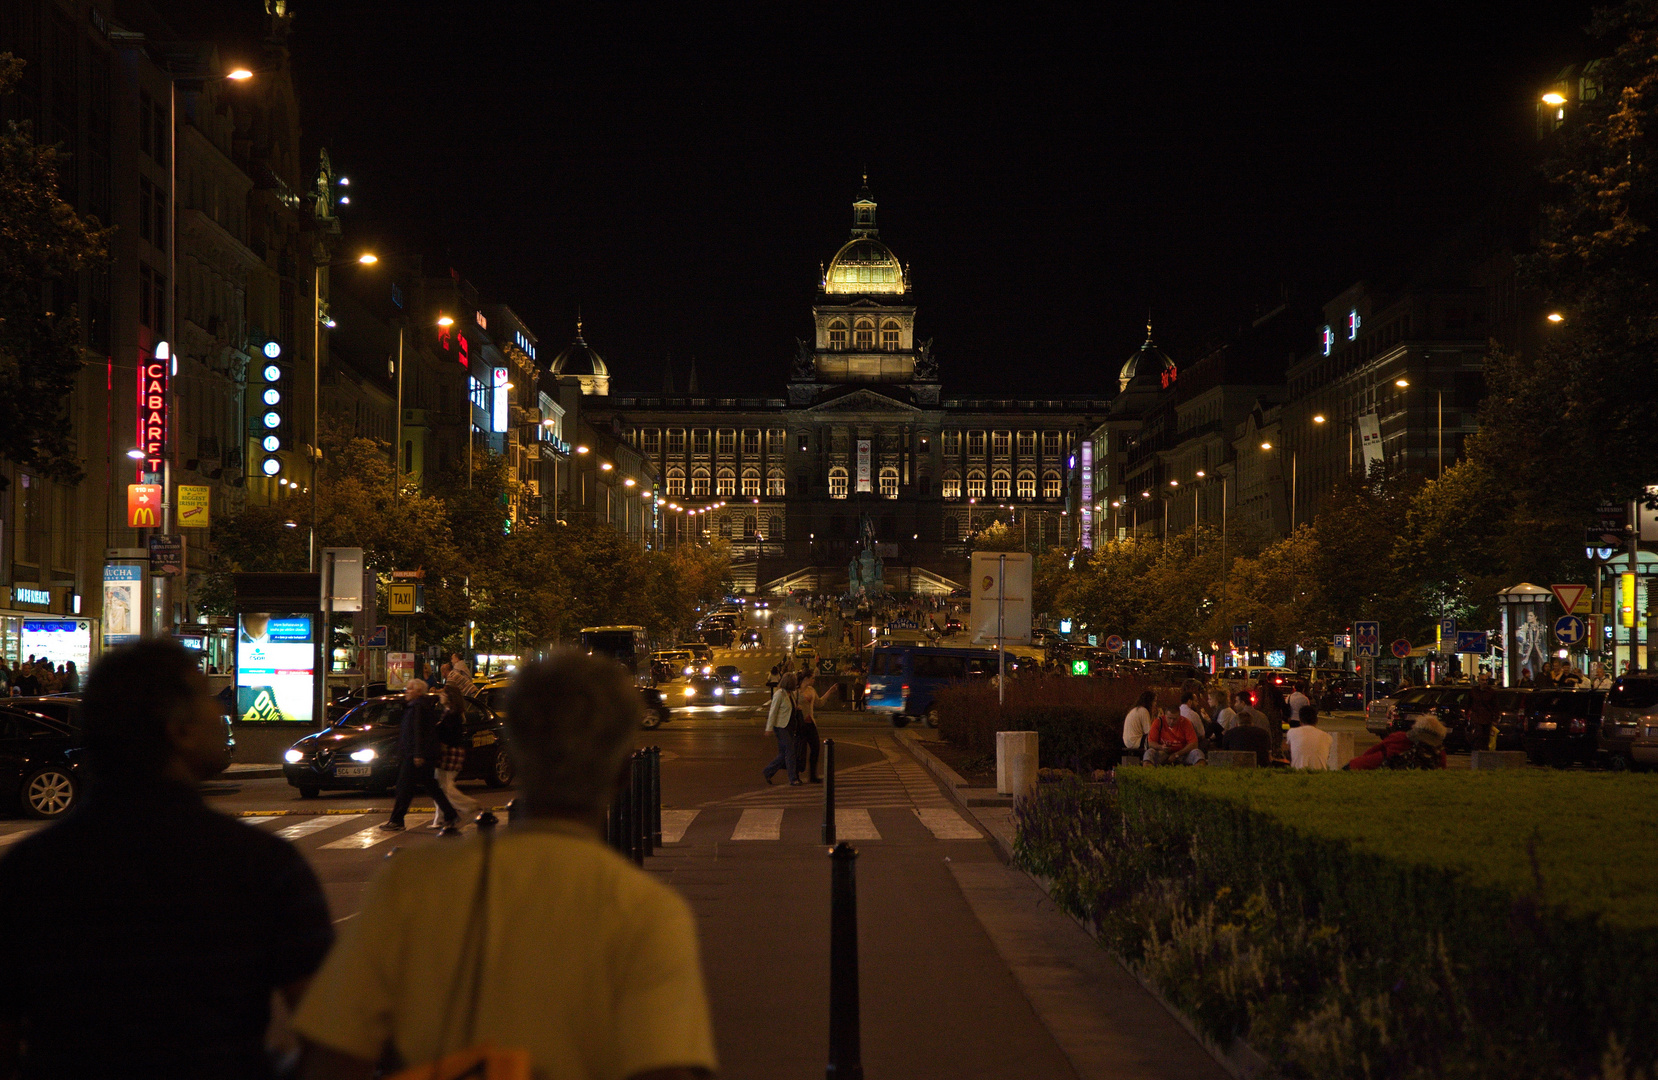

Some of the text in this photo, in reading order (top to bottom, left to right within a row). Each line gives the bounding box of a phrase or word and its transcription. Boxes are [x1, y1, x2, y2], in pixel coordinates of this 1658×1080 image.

[393, 593, 411, 605] TAXI
[883, 627, 890, 636] 11
[1443, 621, 1452, 633] P
[1335, 636, 1342, 645] P
